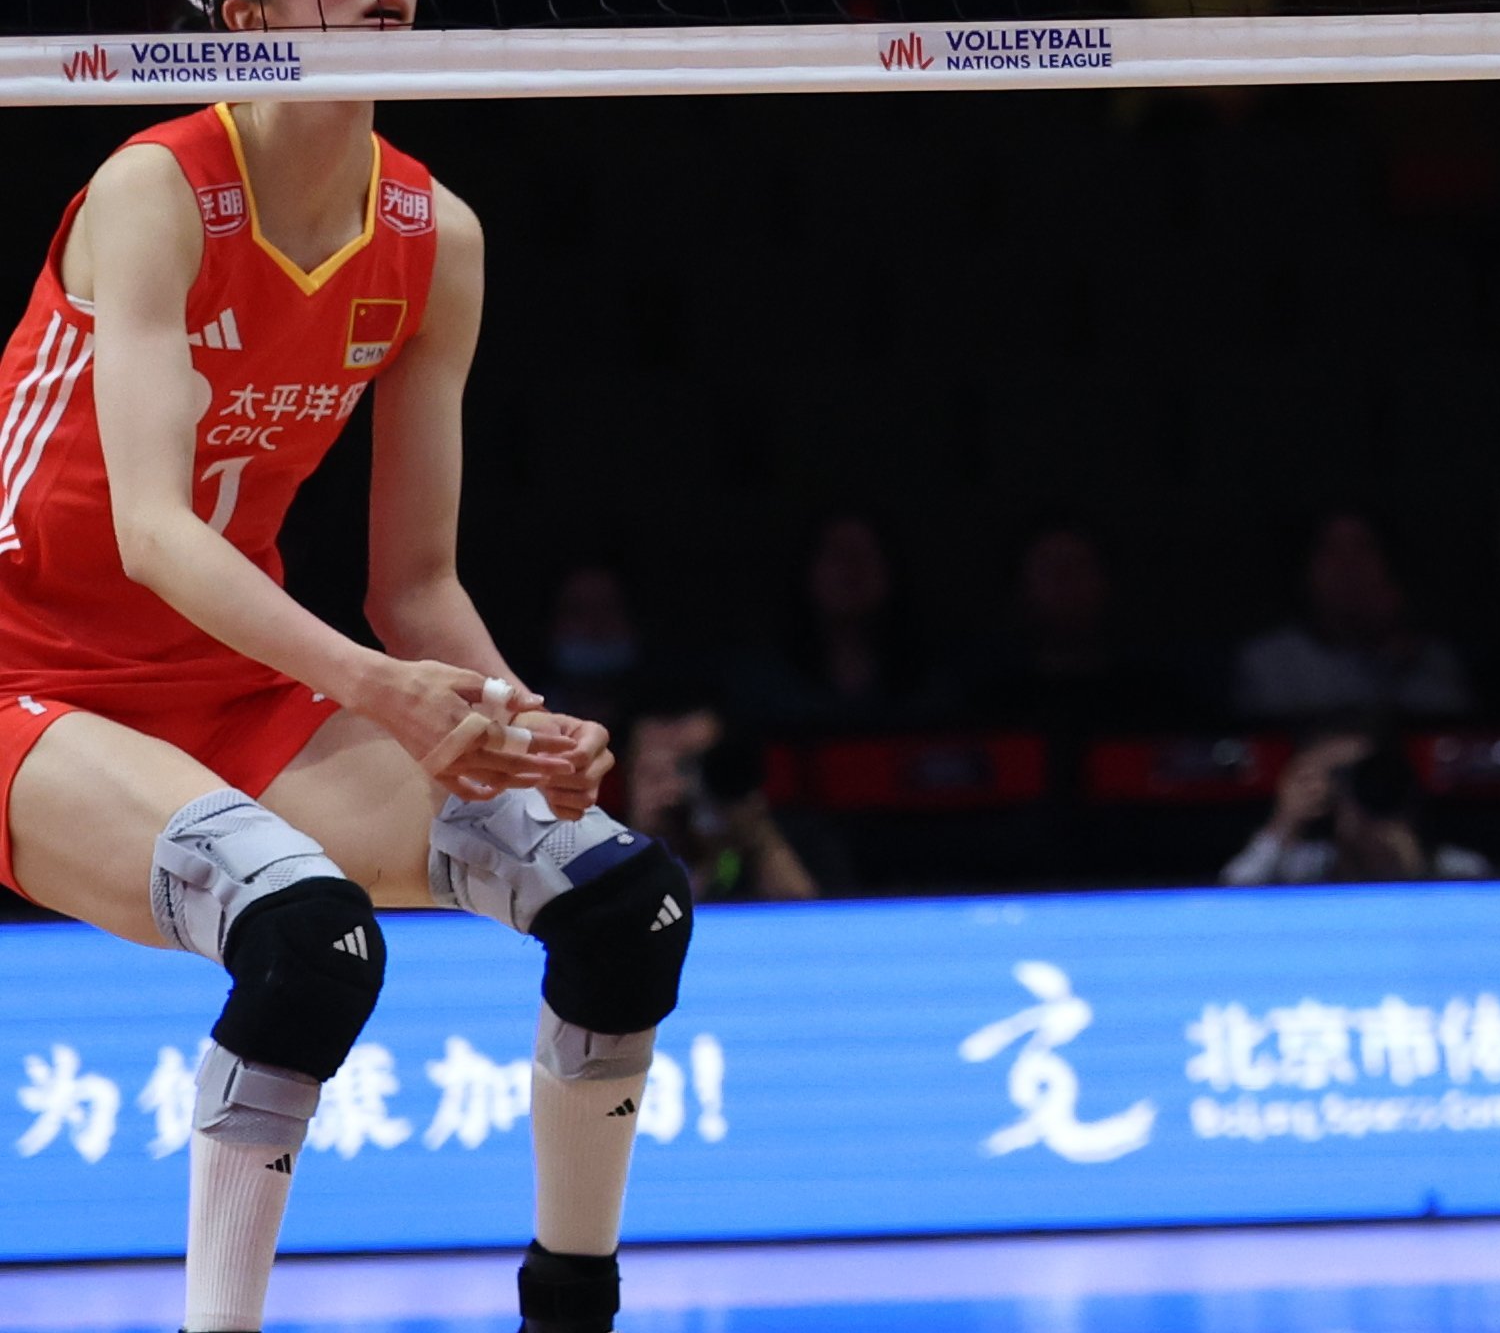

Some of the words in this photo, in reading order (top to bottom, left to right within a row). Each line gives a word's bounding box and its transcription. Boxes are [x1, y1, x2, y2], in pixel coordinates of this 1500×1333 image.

[946, 28, 1111, 51] VOLLEYBALL
[131, 41, 300, 64] VOLLEYBALL
[880, 32, 934, 71] VNL
[947, 55, 1031, 70] NATIONS
[1039, 53, 1112, 68] LEAGUE
[63, 44, 118, 83] VNL
[131, 67, 218, 83] NATIONS
[226, 65, 301, 82] LEAGUE
[206, 424, 284, 451] CPIC
